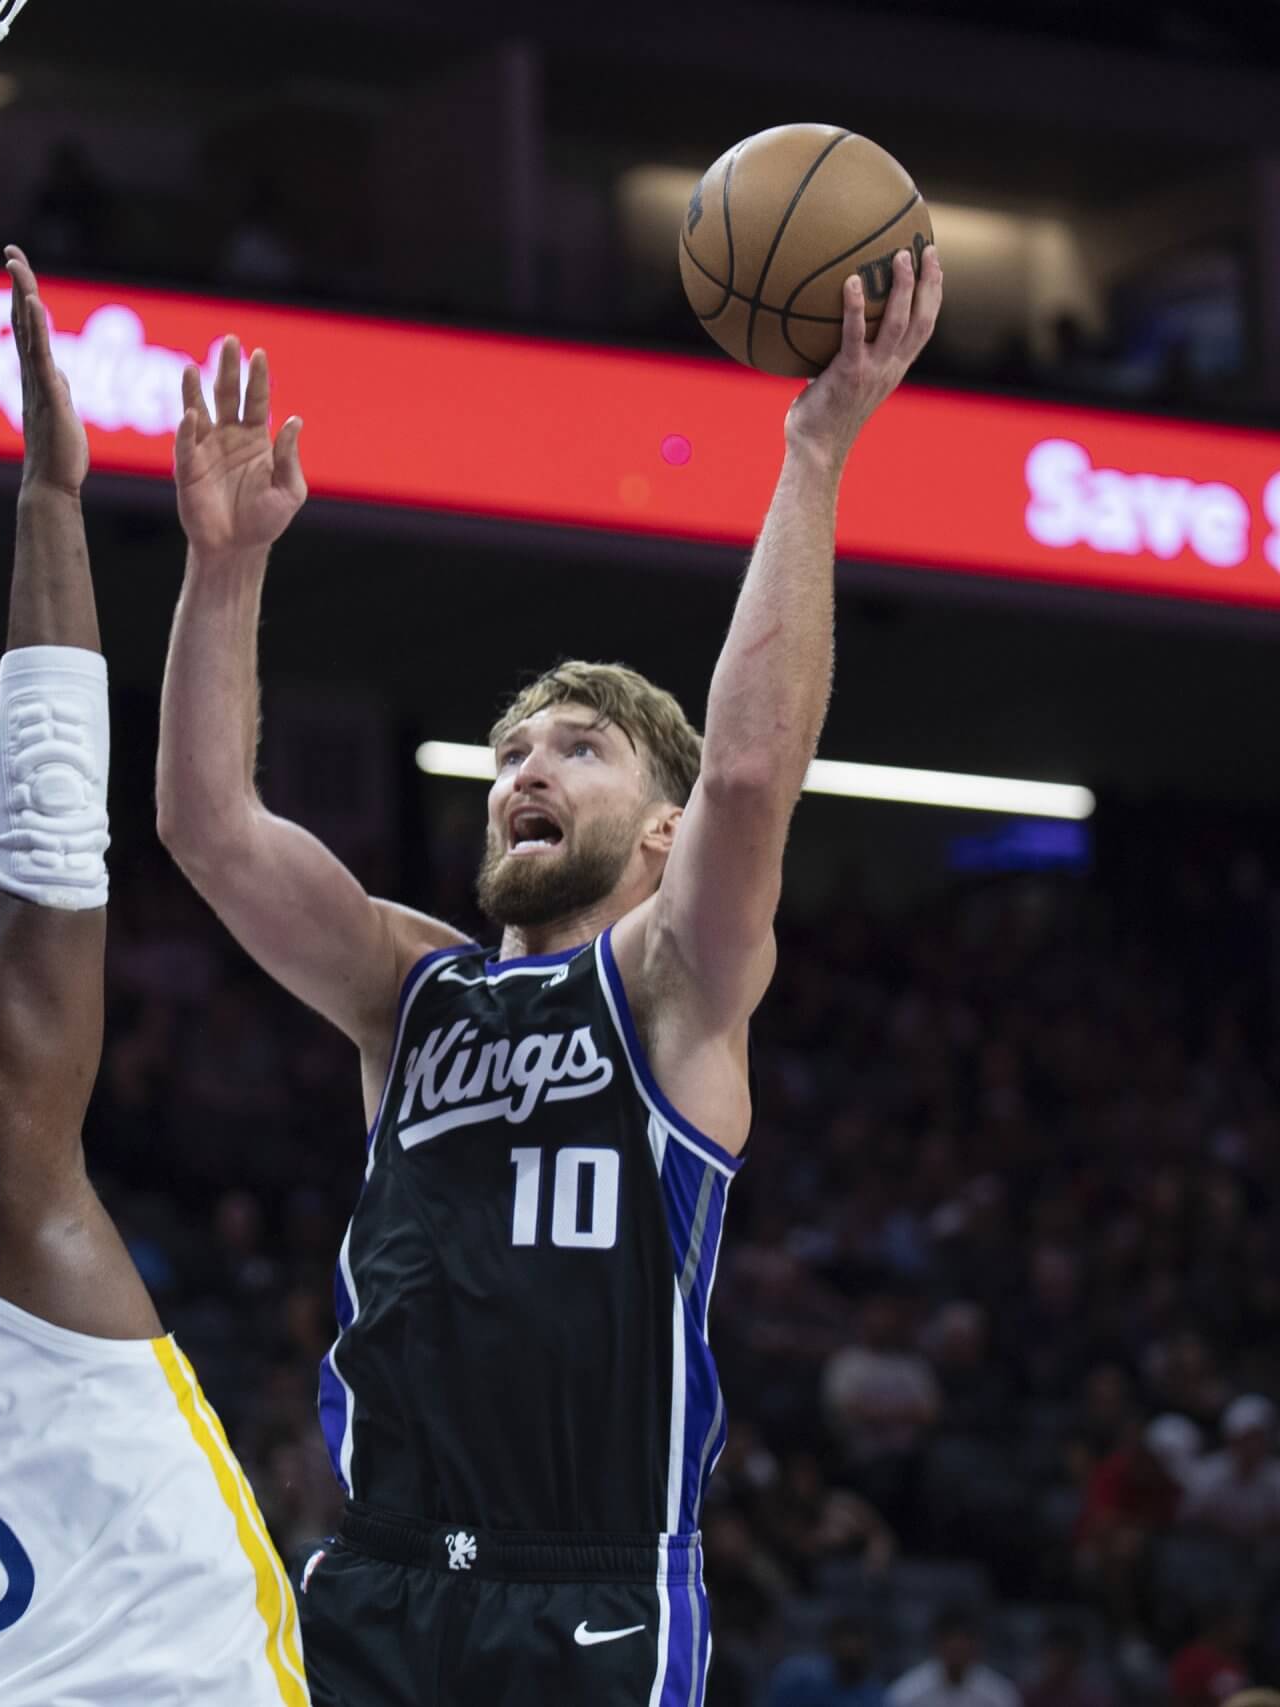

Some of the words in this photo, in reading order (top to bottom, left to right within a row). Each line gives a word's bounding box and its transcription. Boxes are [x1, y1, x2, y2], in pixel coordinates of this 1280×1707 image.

[1023, 437, 1251, 568] Save
[398, 1018, 613, 1126] Kings
[510, 1147, 620, 1249] 10
